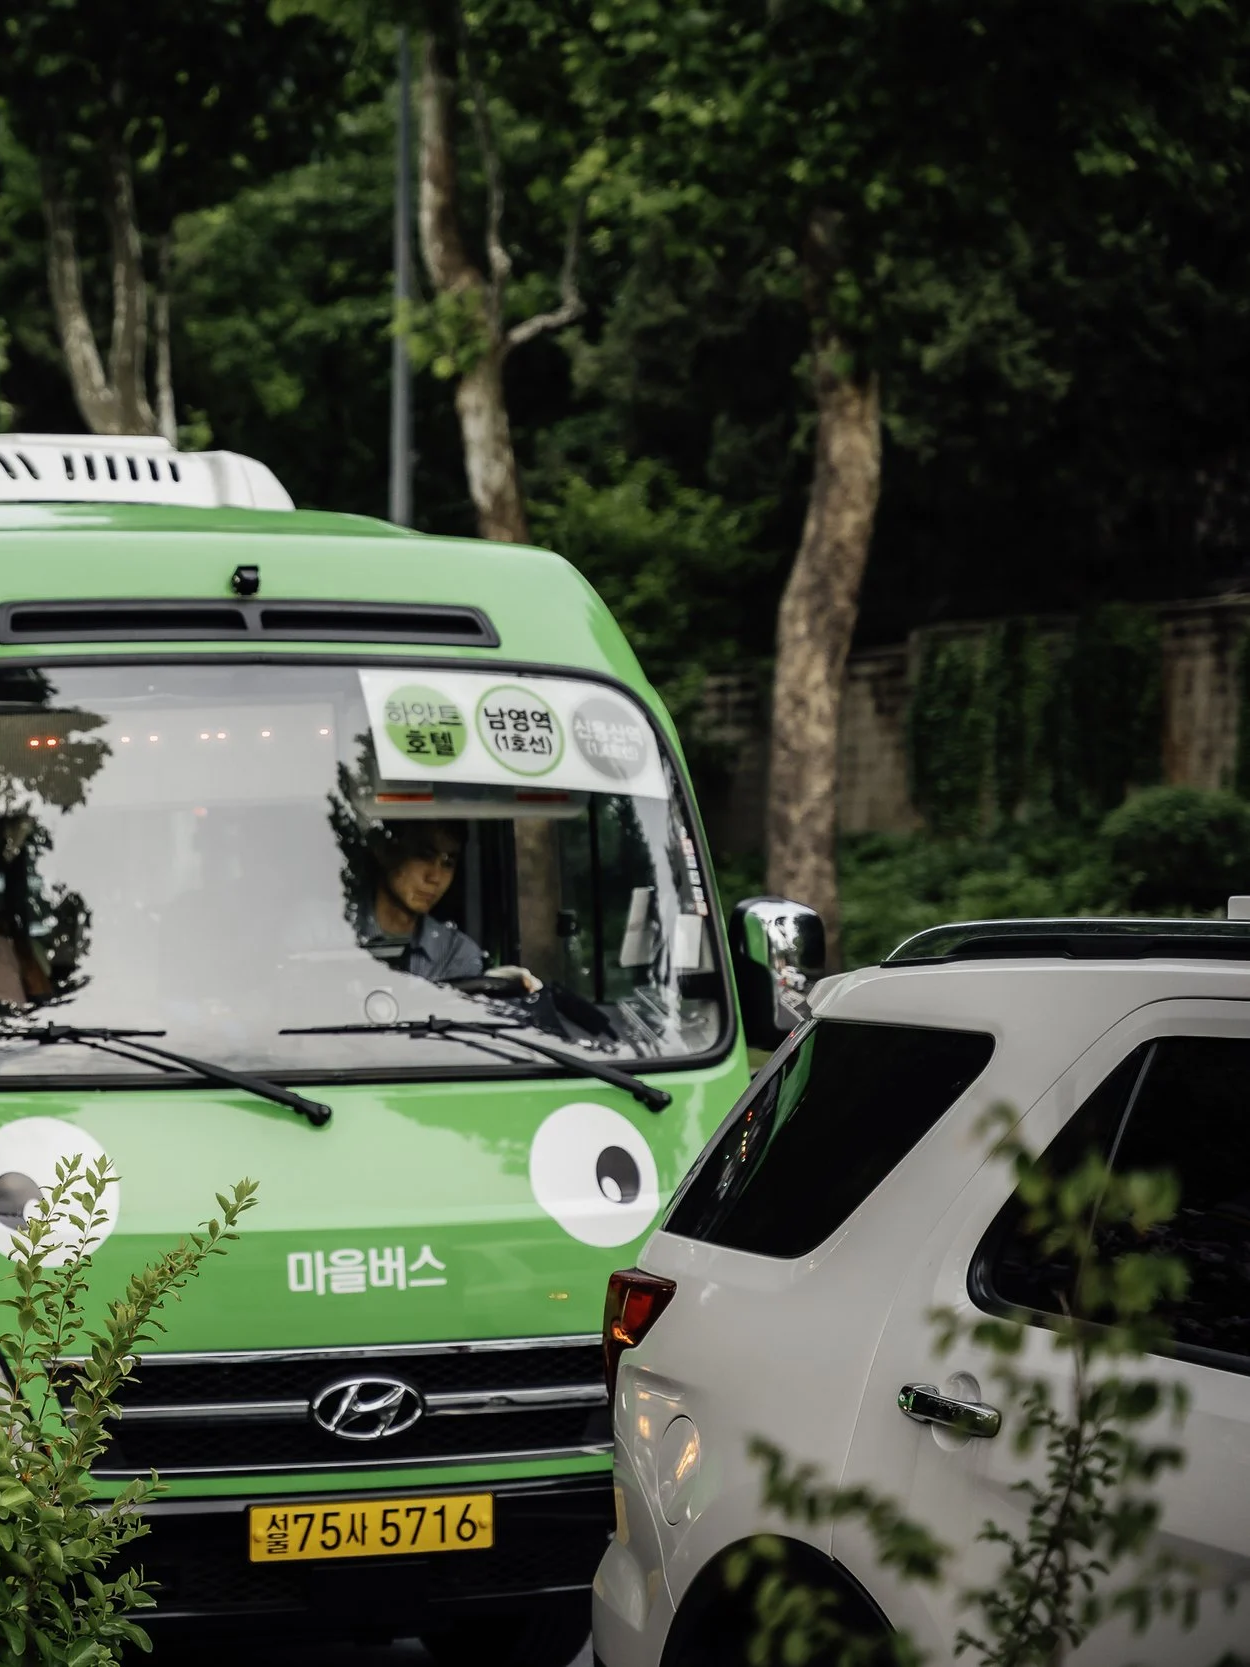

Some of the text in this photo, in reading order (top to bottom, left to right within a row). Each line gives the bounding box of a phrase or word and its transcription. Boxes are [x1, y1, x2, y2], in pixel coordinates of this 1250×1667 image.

[385, 701, 462, 727] 하얏트
[483, 705, 553, 734] 남영역
[406, 730, 456, 756] 호텔
[494, 733, 553, 757] (1호선)
[286, 1244, 447, 1296] 마을버스
[380, 1503, 478, 1548] 5716
